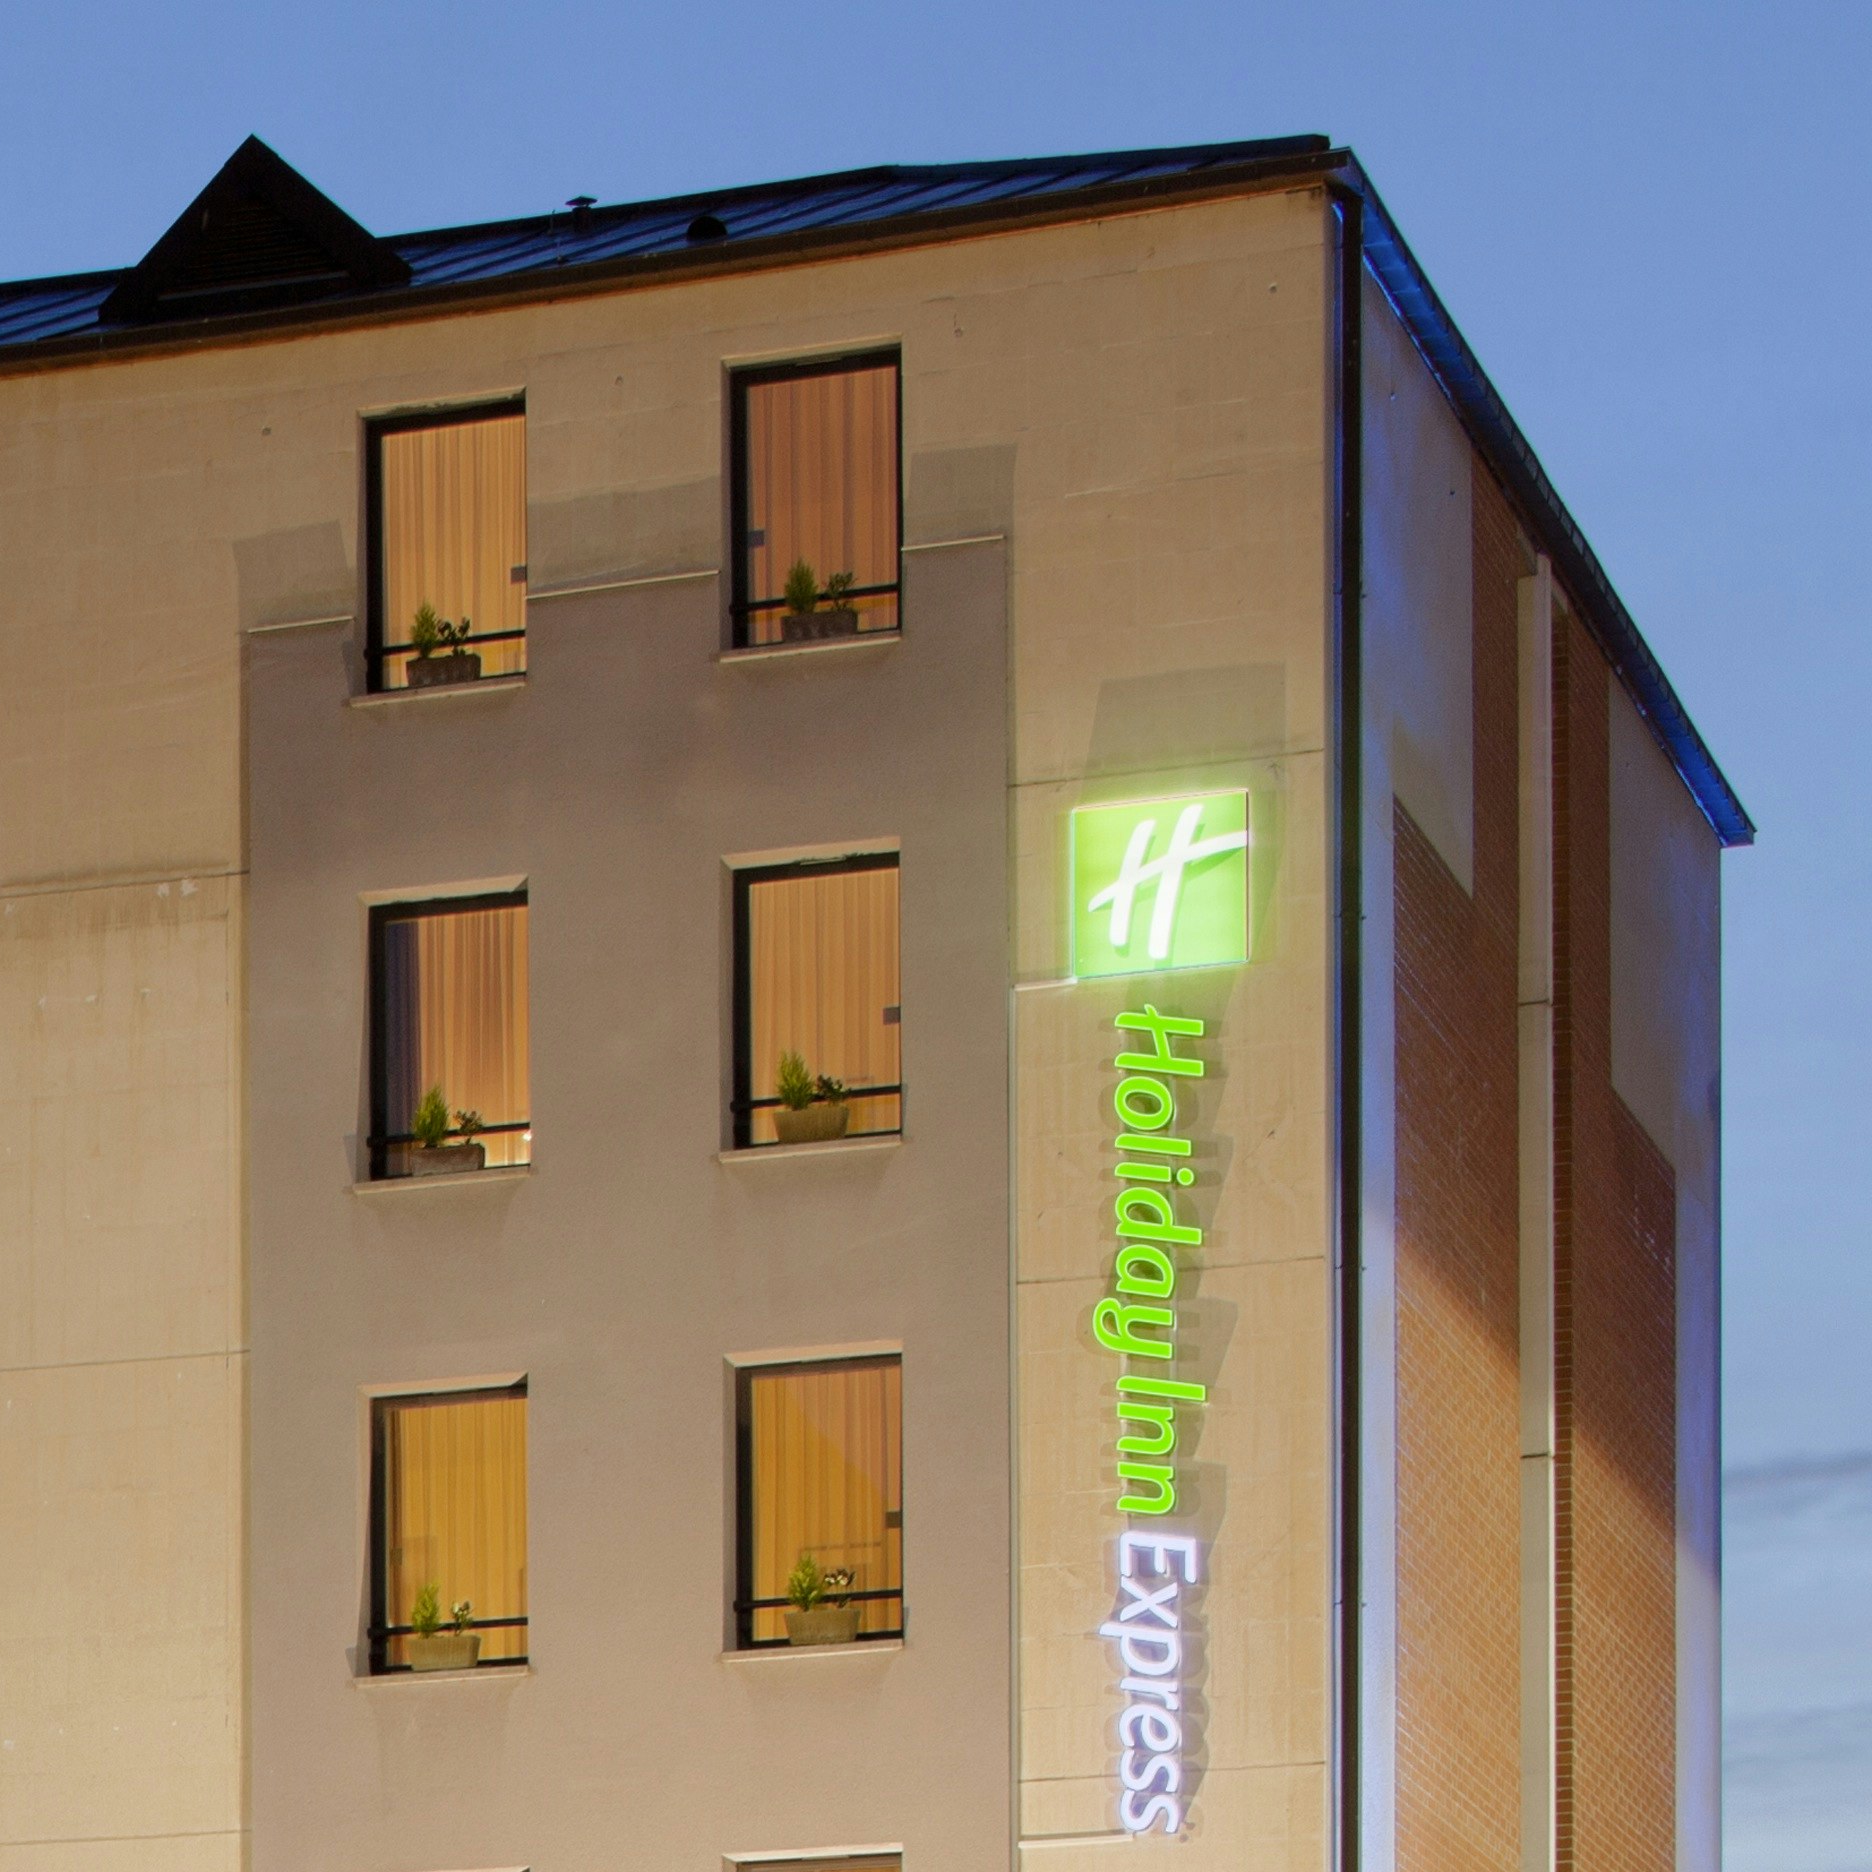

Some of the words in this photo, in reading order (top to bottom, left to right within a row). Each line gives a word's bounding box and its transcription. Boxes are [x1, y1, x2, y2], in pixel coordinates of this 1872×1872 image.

[1093, 1004, 1204, 1358] Holiday
[1116, 1375, 1205, 1514] Inn
[1099, 1531, 1196, 1834] Express
